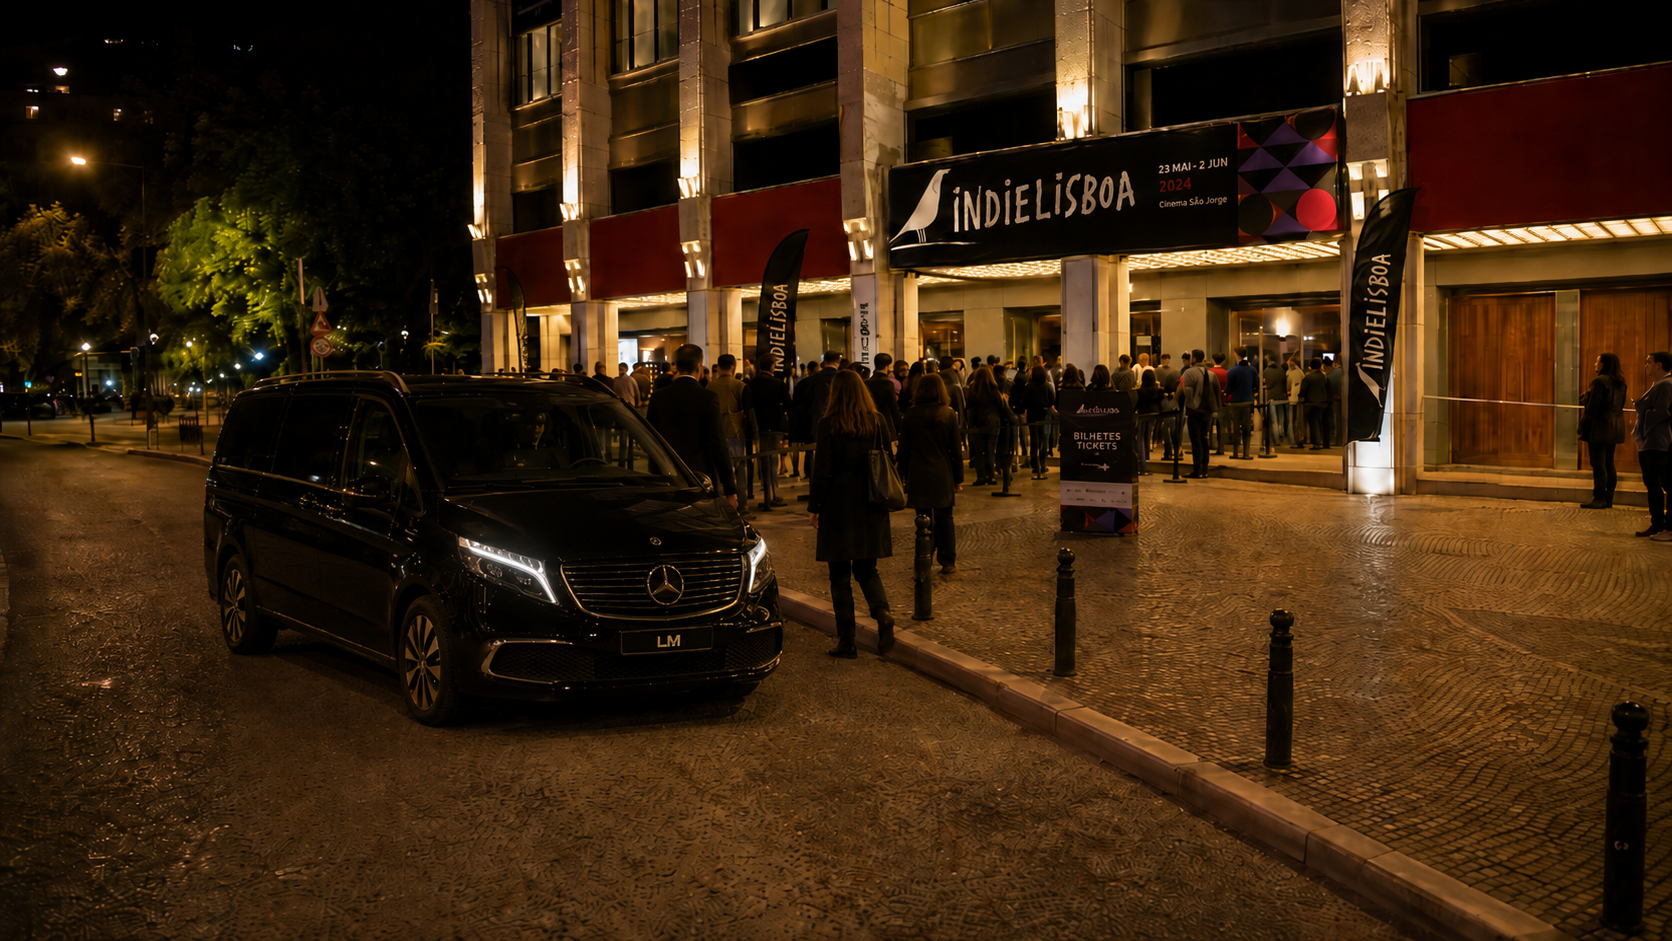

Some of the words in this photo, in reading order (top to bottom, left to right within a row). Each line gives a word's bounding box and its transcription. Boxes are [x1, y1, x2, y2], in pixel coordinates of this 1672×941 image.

[1158, 164, 1170, 175] 23
[1172, 161, 1192, 173] MAI
[1199, 160, 1206, 170] 2
[1207, 156, 1229, 169] JUN
[1159, 177, 1192, 193] 2024
[1158, 199, 1188, 209] Cinema
[1205, 196, 1228, 206] Jorge
[1073, 431, 1122, 441] BILHETES
[1076, 441, 1118, 451] TICKETS
[656, 634, 681, 649] LM
